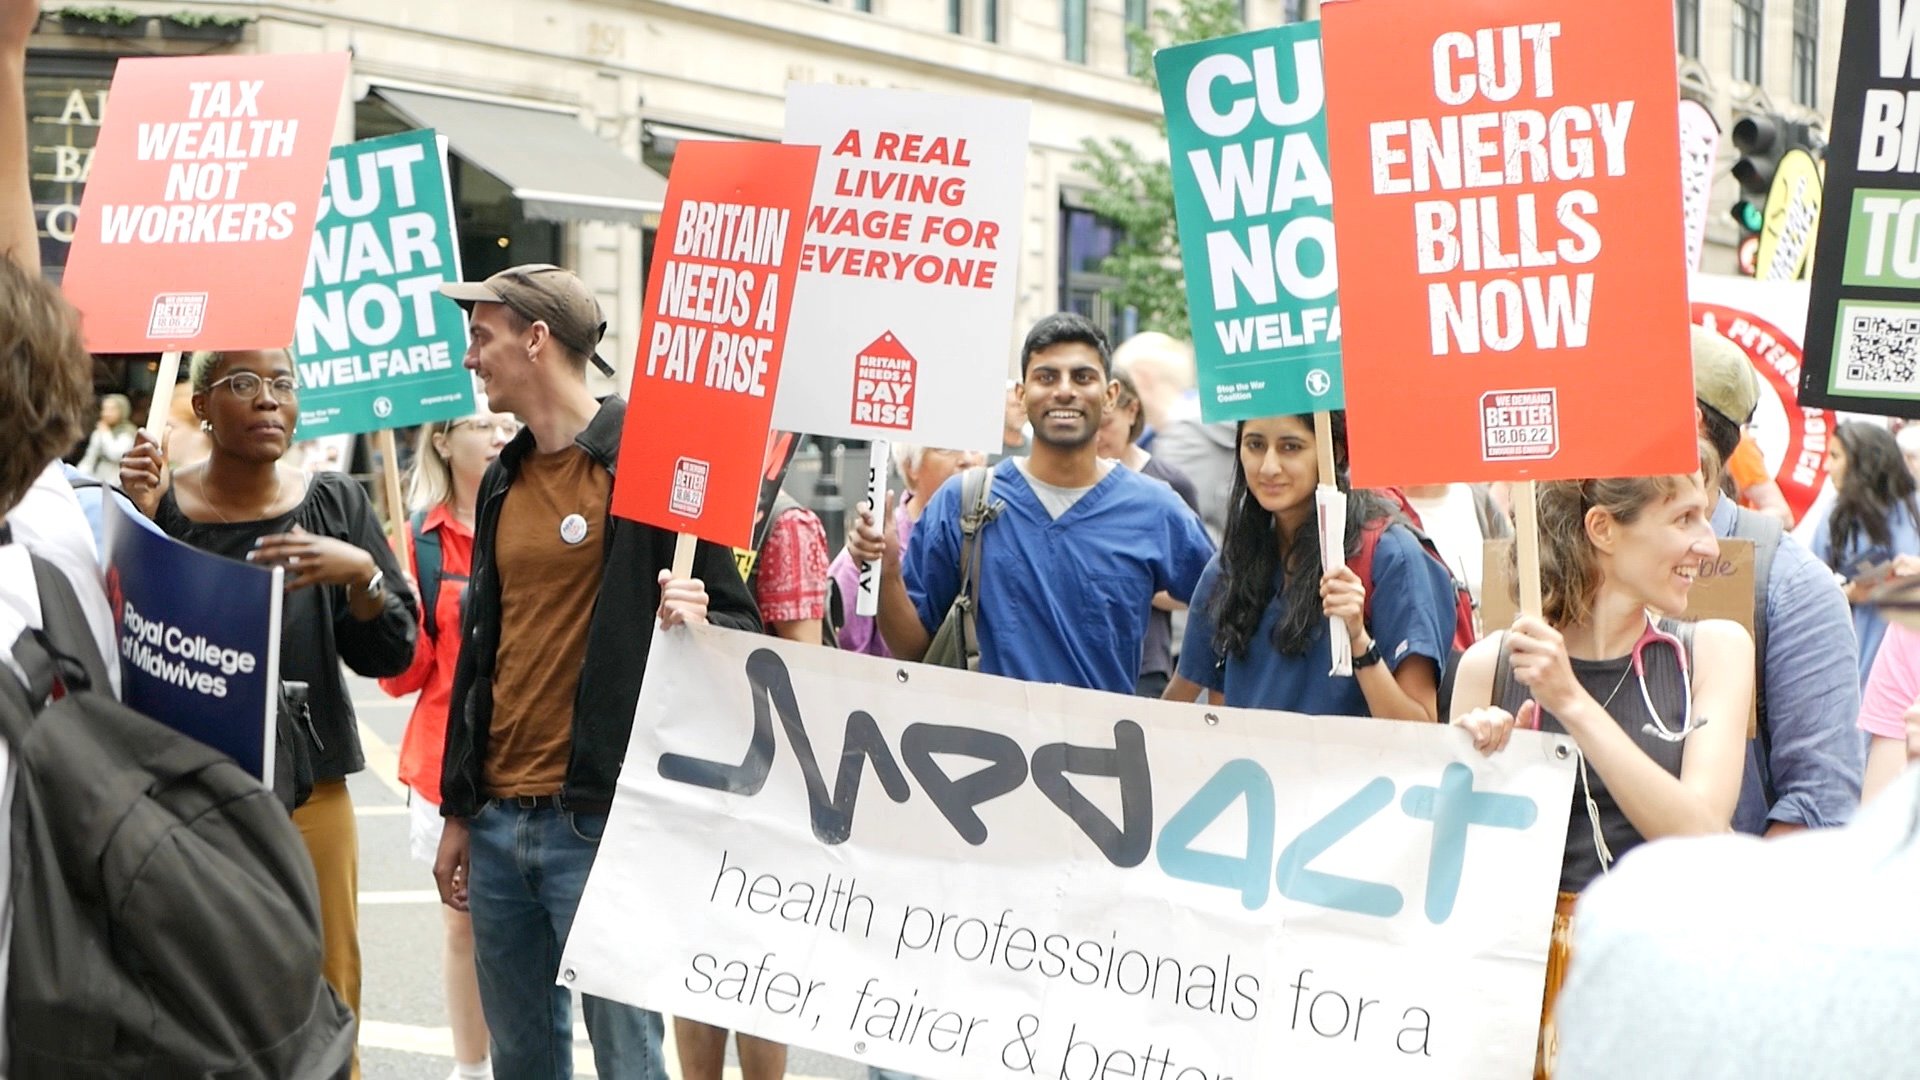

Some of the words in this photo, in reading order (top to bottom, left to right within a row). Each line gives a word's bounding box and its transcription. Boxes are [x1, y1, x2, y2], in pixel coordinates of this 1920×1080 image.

[1186, 38, 1325, 137] CU
[1432, 22, 1561, 105] CUT
[188, 80, 264, 119] TAX
[137, 119, 298, 161] WEALTH
[832, 129, 862, 158] A
[873, 131, 971, 167] REAL
[1370, 100, 1635, 195] ENERGY
[1857, 89, 1920, 173] BI
[164, 161, 248, 202] NOT
[834, 168, 966, 207] LIVING
[1187, 131, 1333, 222] WA
[100, 201, 297, 244] WORKERS
[673, 199, 790, 267] BRITAIN
[920, 215, 1000, 250] FOR
[1414, 189, 1602, 275] BILLS
[800, 244, 998, 289] EVERYONE
[1206, 216, 1338, 311] NO
[296, 273, 444, 356] NOT
[658, 260, 755, 327] NEEDS
[754, 273, 779, 332] A
[1428, 272, 1595, 356] NOW
[1214, 305, 1342, 355] WELFA
[299, 341, 452, 389] WELFARE
[646, 320, 707, 384] PAY
[704, 330, 774, 397] RISE
[859, 367, 900, 381] NEEDS
[901, 372, 913, 383] A
[860, 355, 911, 371] BRITAIN
[857, 379, 913, 405] PAY
[1216, 384, 1235, 394] Stop
[1236, 382, 1249, 391] the
[1250, 380, 1265, 390] War
[1217, 392, 1252, 403] Coalition
[855, 401, 910, 426] RISE
[1486, 405, 1552, 427] BETTER
[1492, 427, 1548, 444] 18.06.22
[1699, 554, 1738, 578] ble
[124, 601, 163, 647] Royal
[165, 626, 256, 675] College
[132, 640, 227, 698] Midwives
[710, 850, 875, 938] health
[895, 904, 1260, 1021] professionals
[1290, 969, 1380, 1042] for
[1396, 1005, 1432, 1057] a
[685, 952, 826, 1031] safer,
[850, 977, 989, 1057] fairer
[1001, 1013, 1040, 1075] &
[1059, 1023, 1234, 1080] bett
